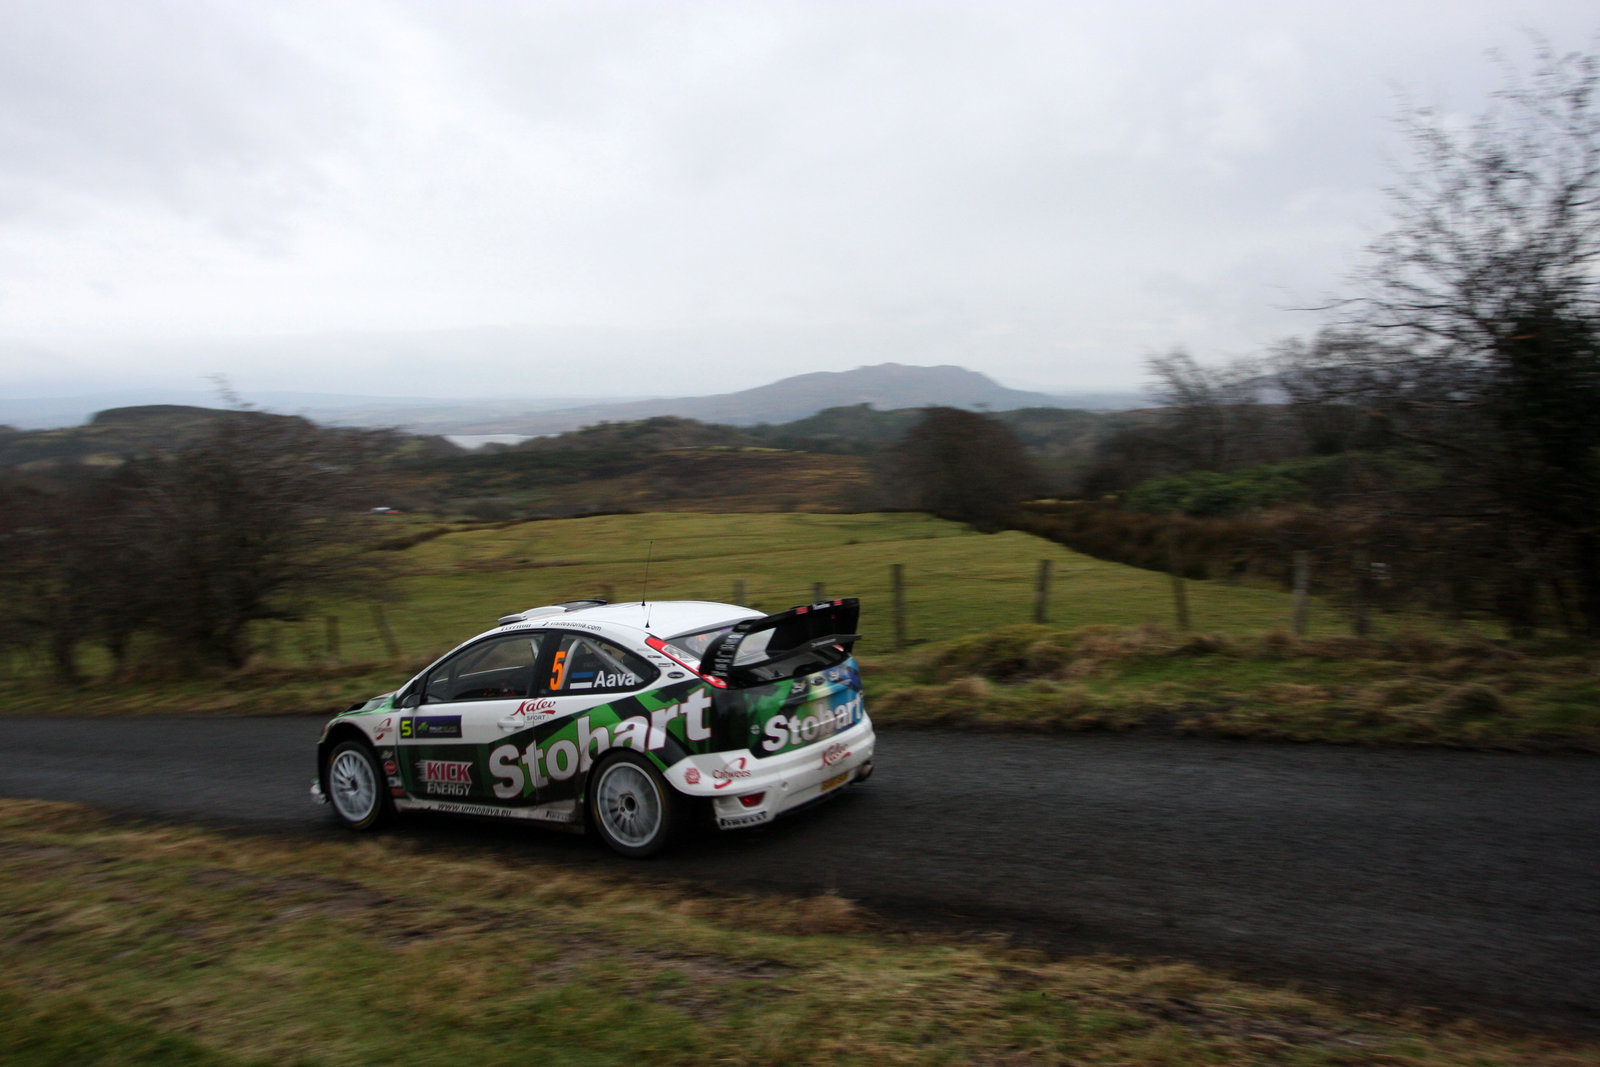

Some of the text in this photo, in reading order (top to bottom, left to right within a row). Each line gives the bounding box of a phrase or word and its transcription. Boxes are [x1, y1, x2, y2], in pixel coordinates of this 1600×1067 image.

[550, 651, 566, 690] 5
[594, 670, 635, 688] Aava
[511, 697, 556, 716] Kalev
[401, 720, 412, 736] 5
[762, 690, 864, 752] Stobart
[488, 686, 712, 799] Stobart
[427, 762, 472, 782] KICK
[427, 782, 471, 797] ENERGY
